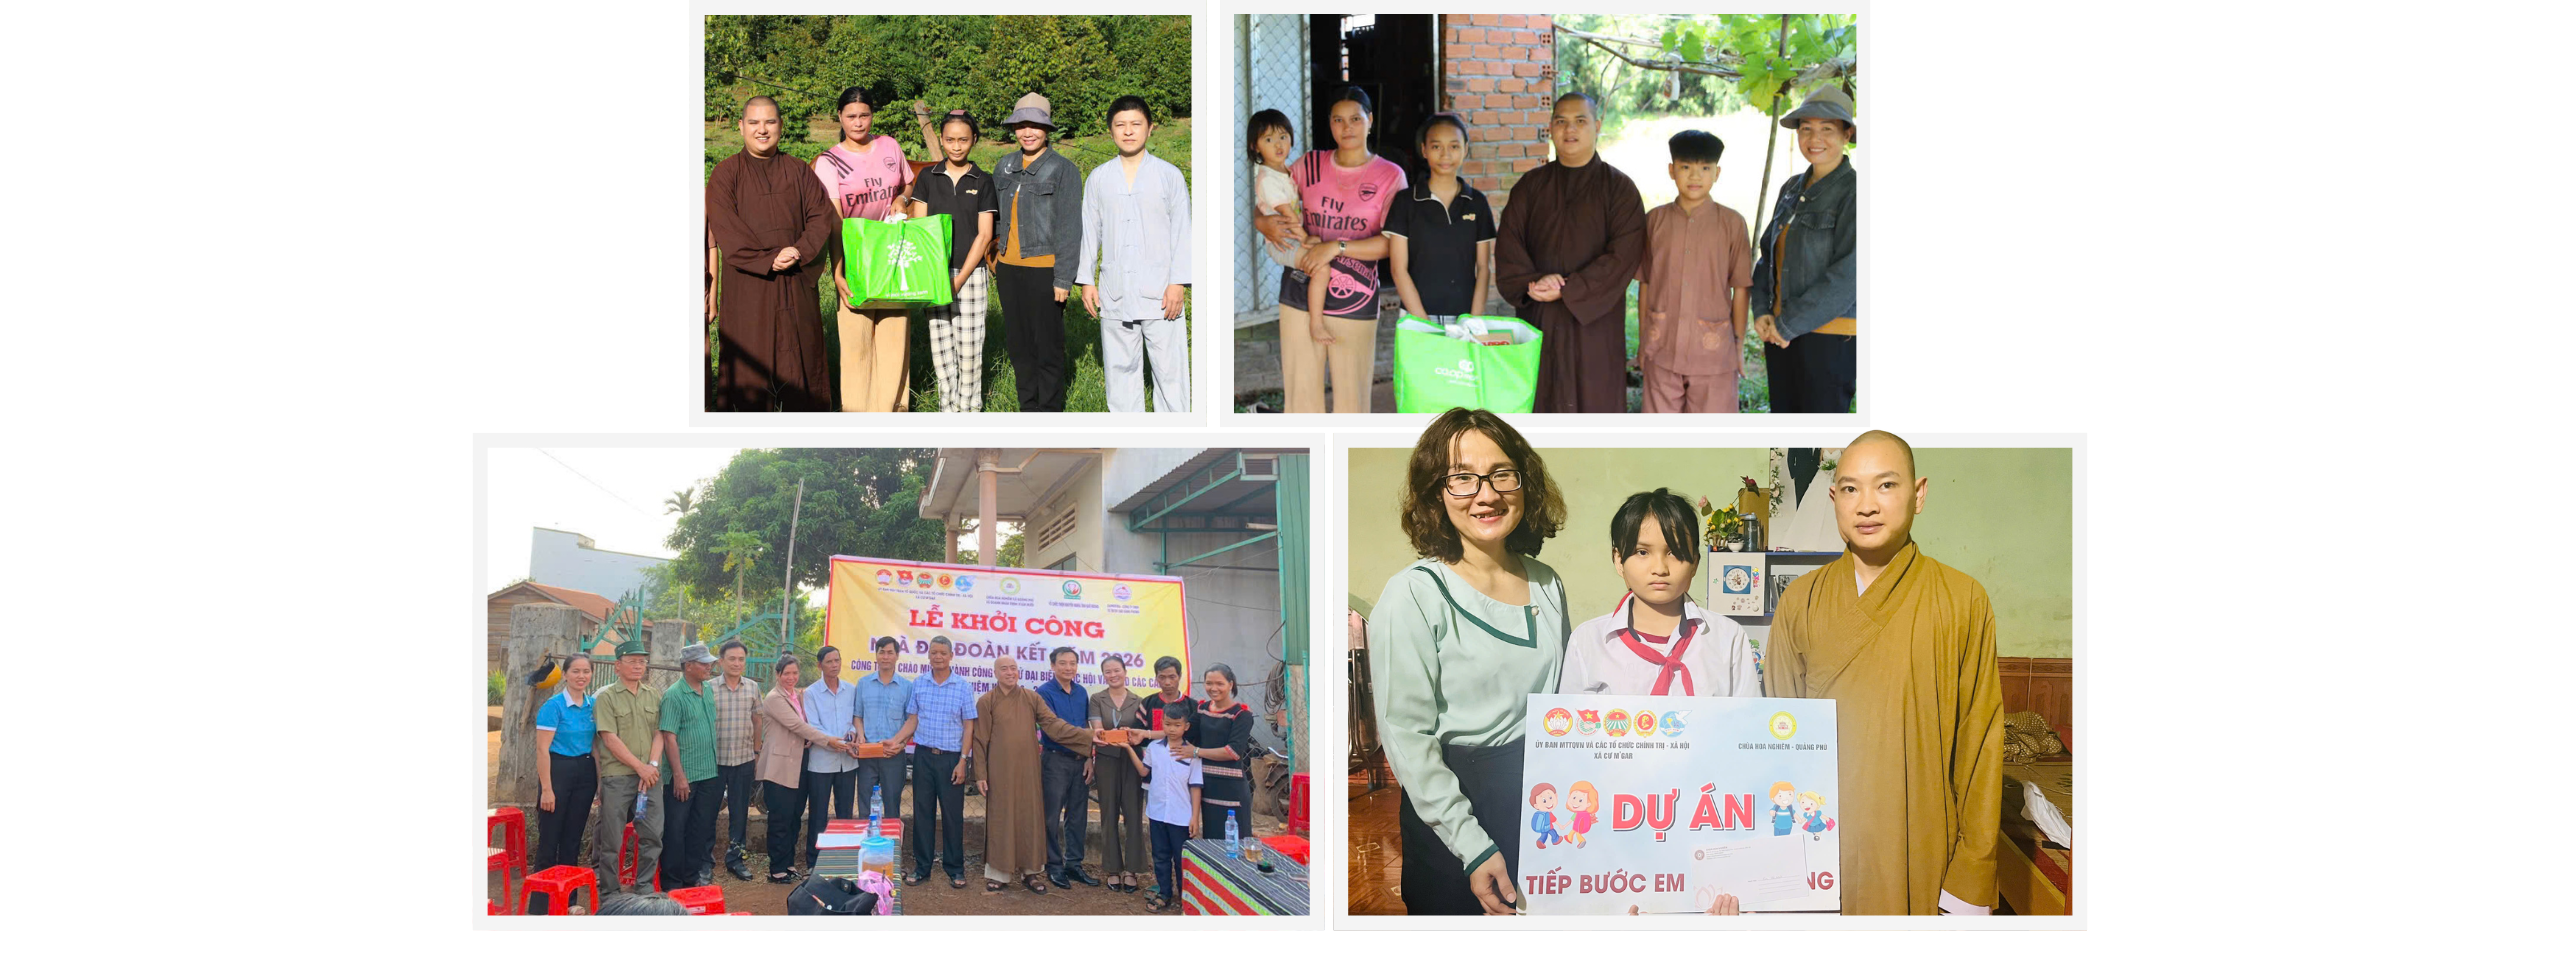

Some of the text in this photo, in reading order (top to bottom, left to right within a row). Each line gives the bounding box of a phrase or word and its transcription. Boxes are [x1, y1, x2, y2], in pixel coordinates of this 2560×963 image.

[864, 177, 882, 187] Fly
[845, 185, 898, 207] Emirate
[1321, 196, 1344, 213] Fly
[909, 604, 1105, 638] LỄ KHỞI CÔNG
[954, 640, 1009, 658] ĐOÀN
[1016, 641, 1047, 661] KẾT
[851, 659, 871, 671] CÔNG
[972, 665, 993, 678] CÔNG
[1612, 782, 1755, 842] DỰ ÁN
[1526, 866, 1572, 895] TIẾP
[1579, 868, 1647, 894] BƯỚC
[1654, 873, 1685, 892] EM
